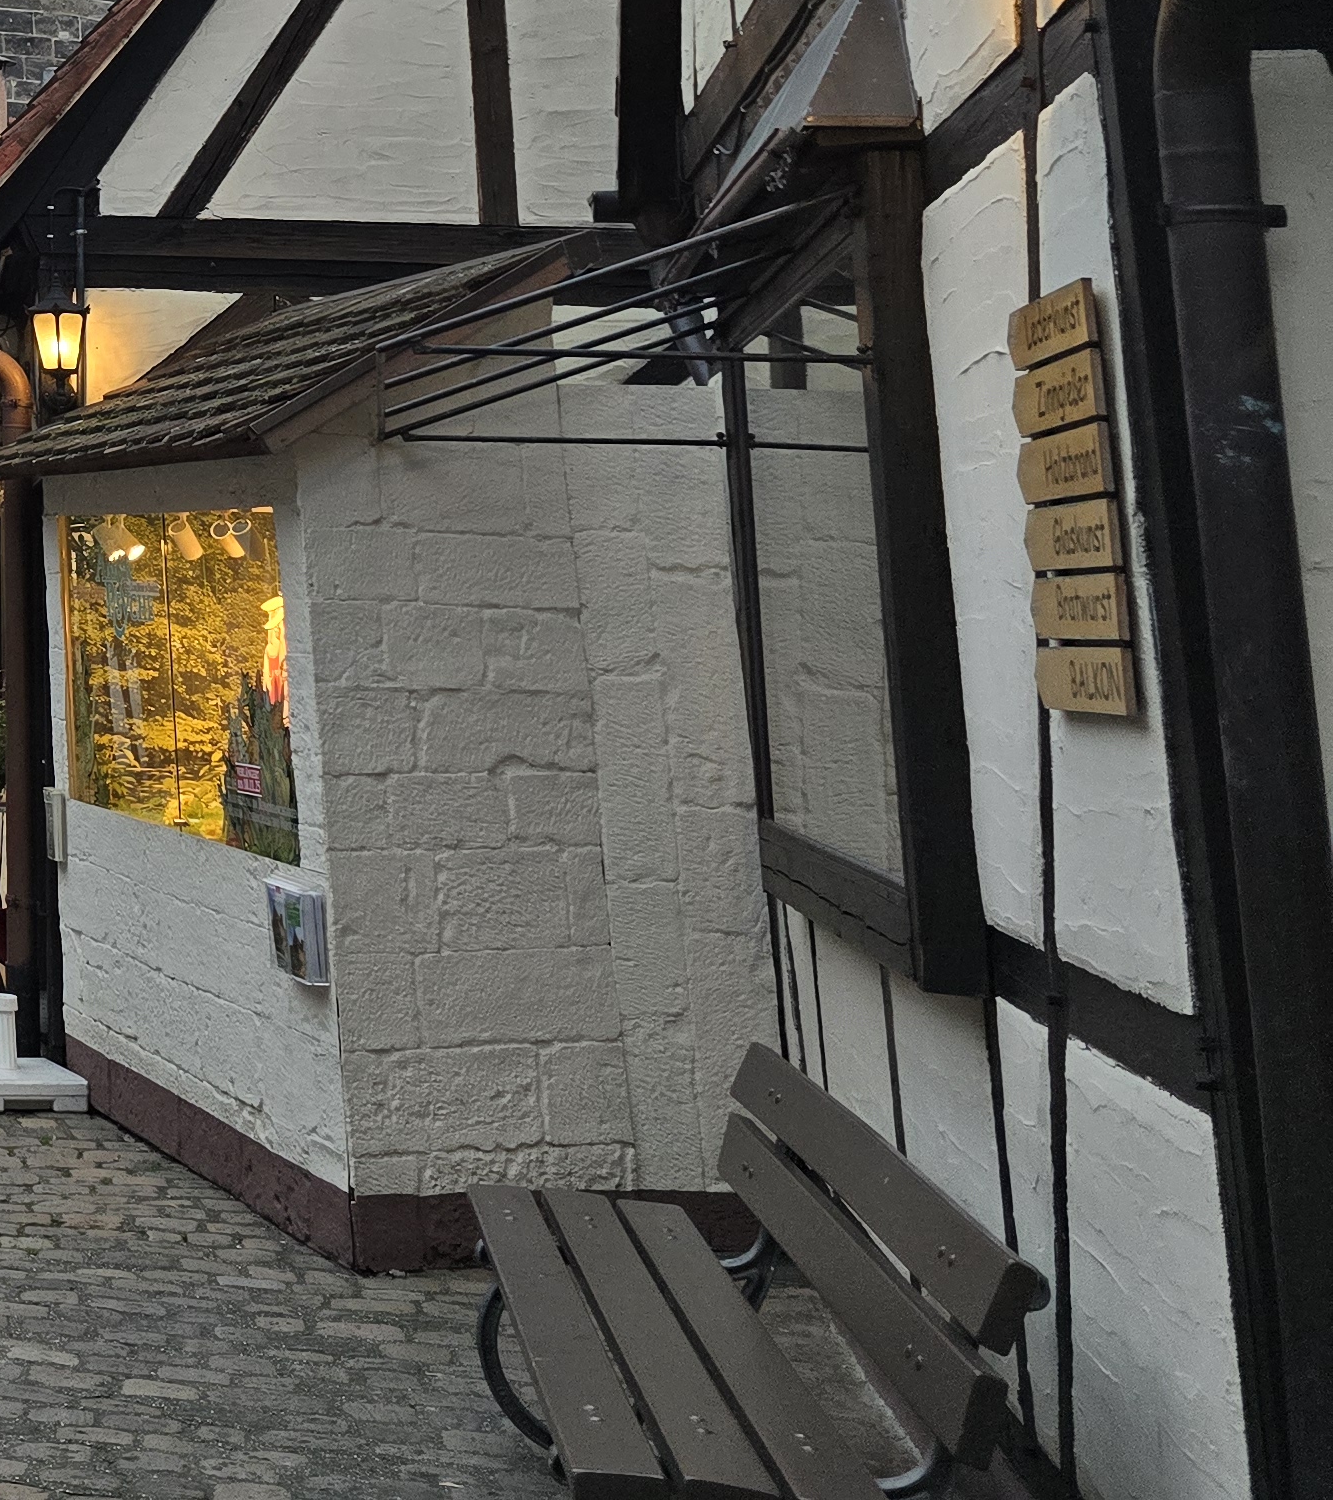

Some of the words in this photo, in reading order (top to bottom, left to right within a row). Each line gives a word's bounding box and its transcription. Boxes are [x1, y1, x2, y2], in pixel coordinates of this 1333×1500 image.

[1023, 292, 1082, 351] Lederkunst
[1035, 366, 1089, 422] Zinngießer
[1044, 436, 1099, 487] Holzbrand
[1052, 514, 1106, 557] Glaskunst
[1056, 583, 1112, 622] Bratwurst
[1069, 660, 1123, 703] BALKON
